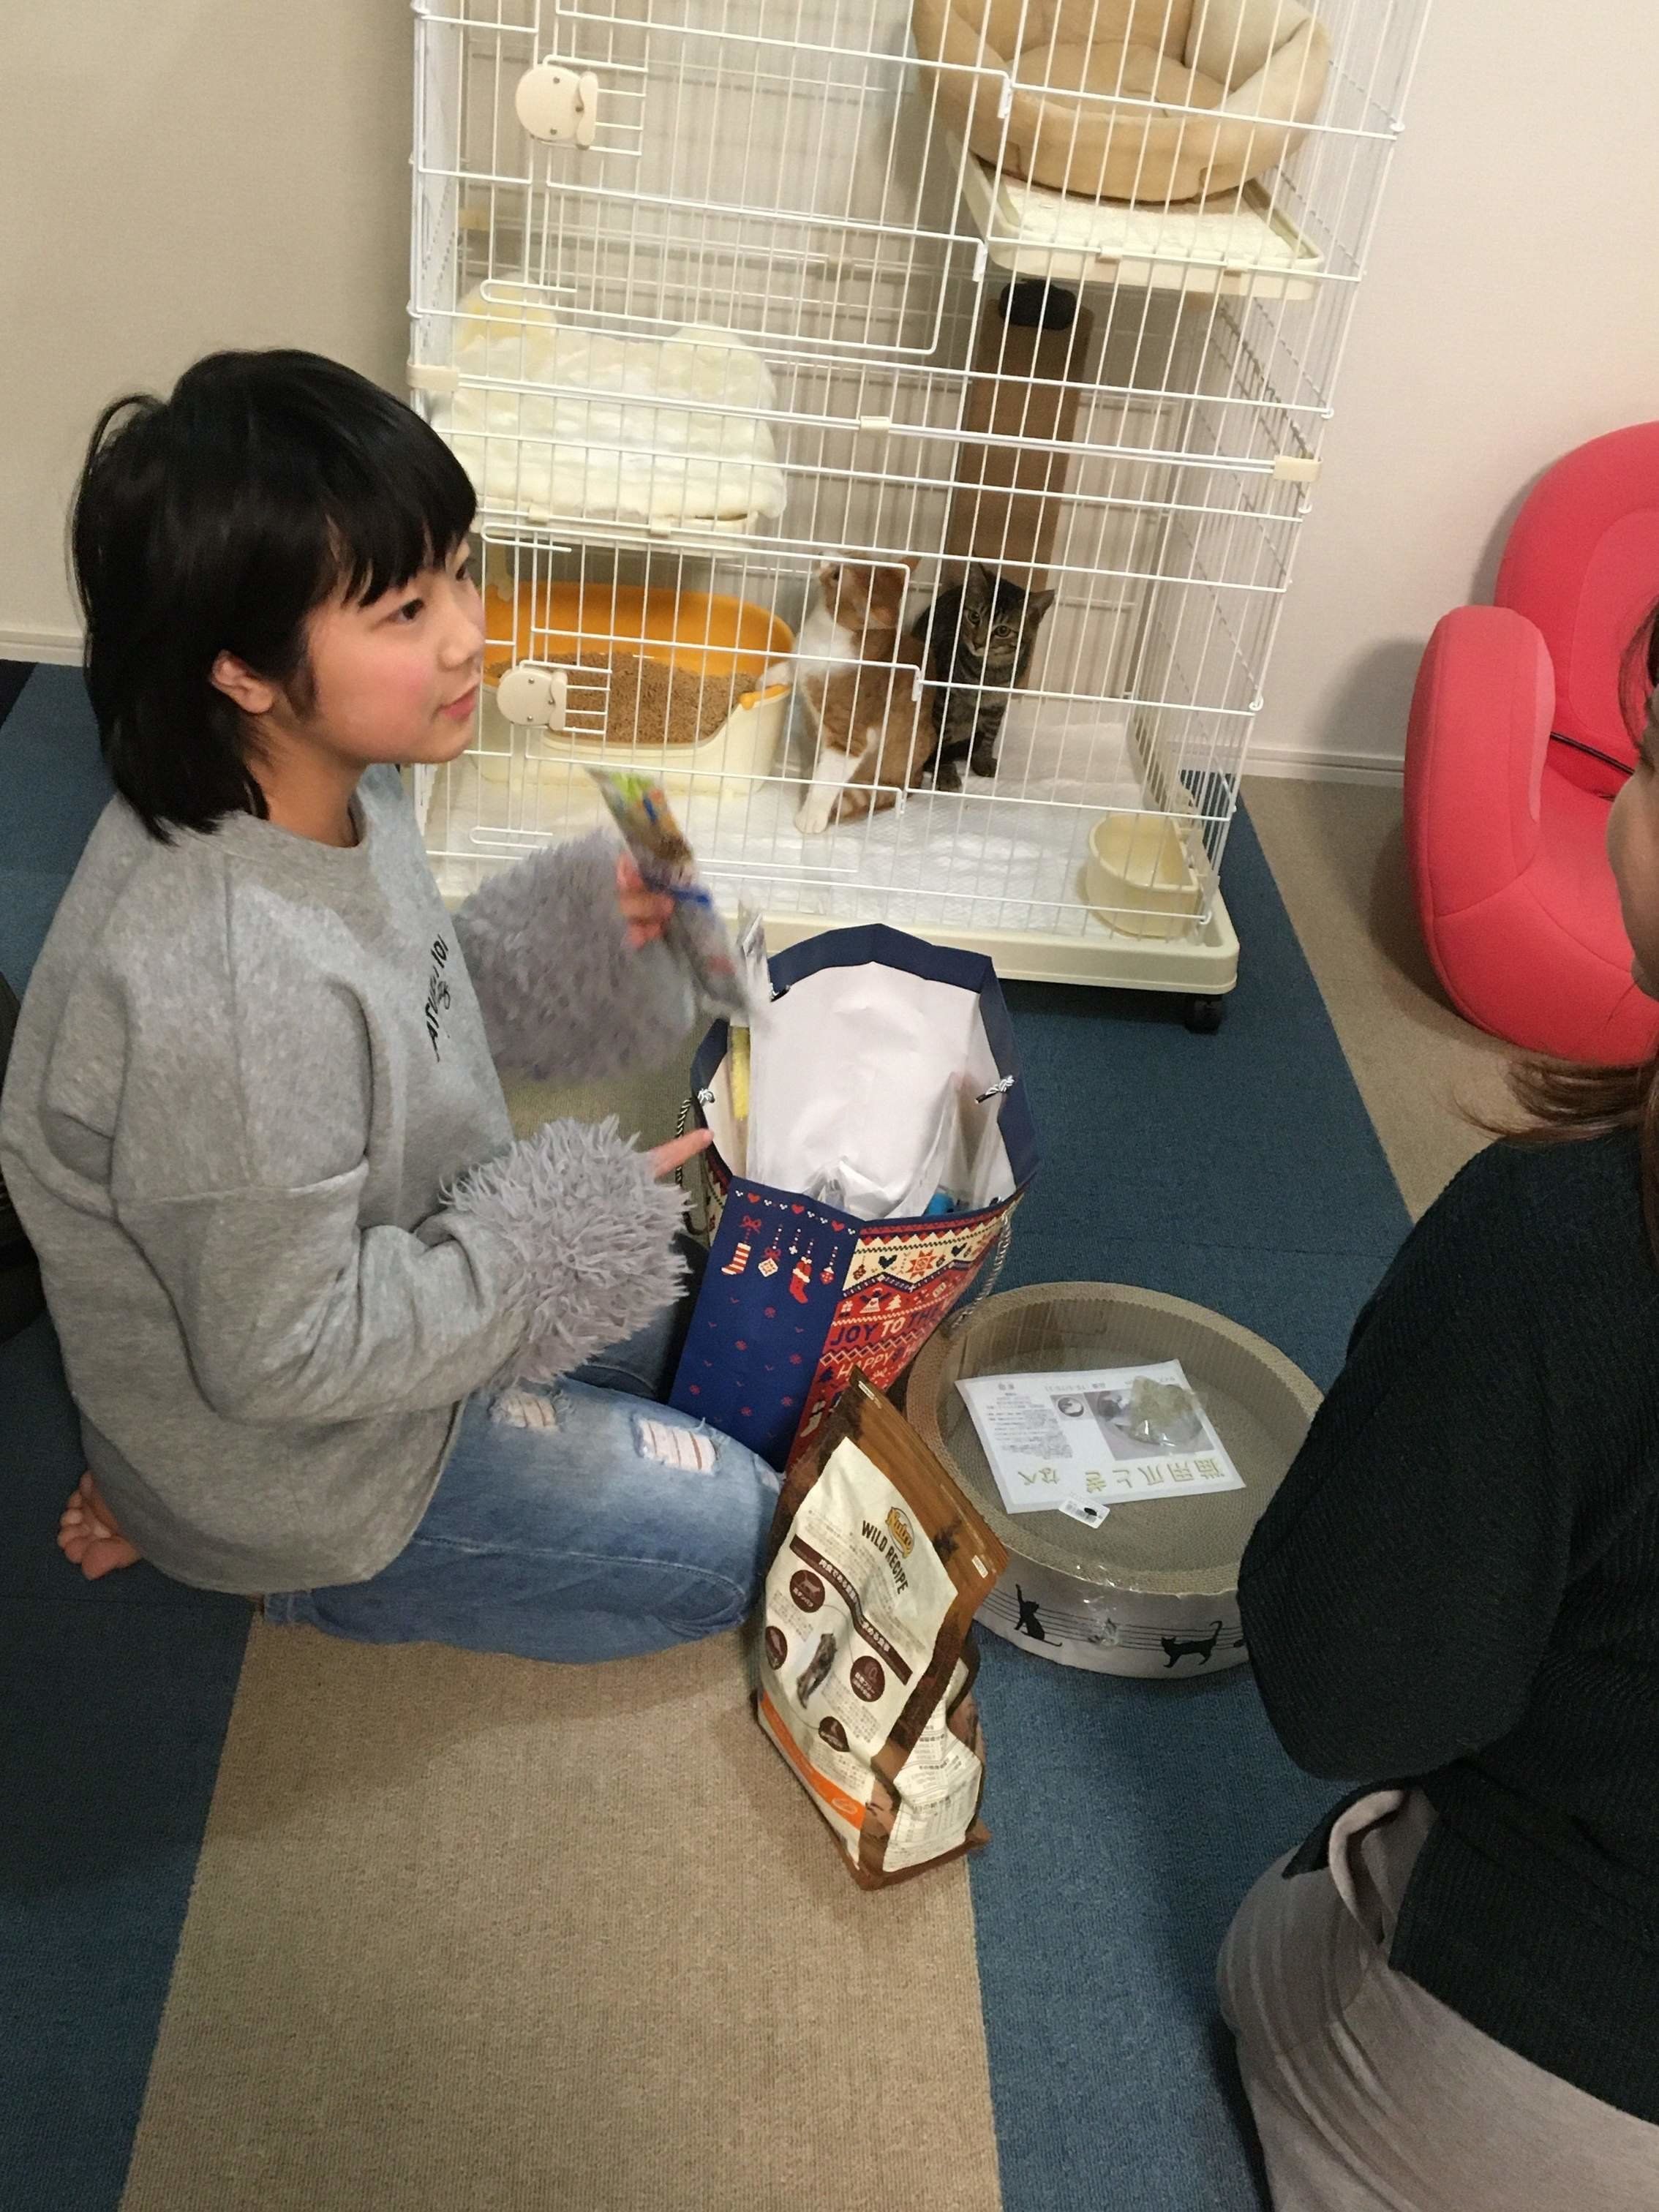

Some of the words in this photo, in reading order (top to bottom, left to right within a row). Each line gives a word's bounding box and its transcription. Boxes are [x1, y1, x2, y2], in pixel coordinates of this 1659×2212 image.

[830, 1324, 879, 1346] JOY
[881, 1317, 906, 1338] TO
[1017, 1467, 1061, 1486] なべ
[1084, 1459, 1225, 1494] 猫用爪とぎ
[861, 1520, 889, 1552] WILD
[884, 1545, 909, 1595] RECIPE
